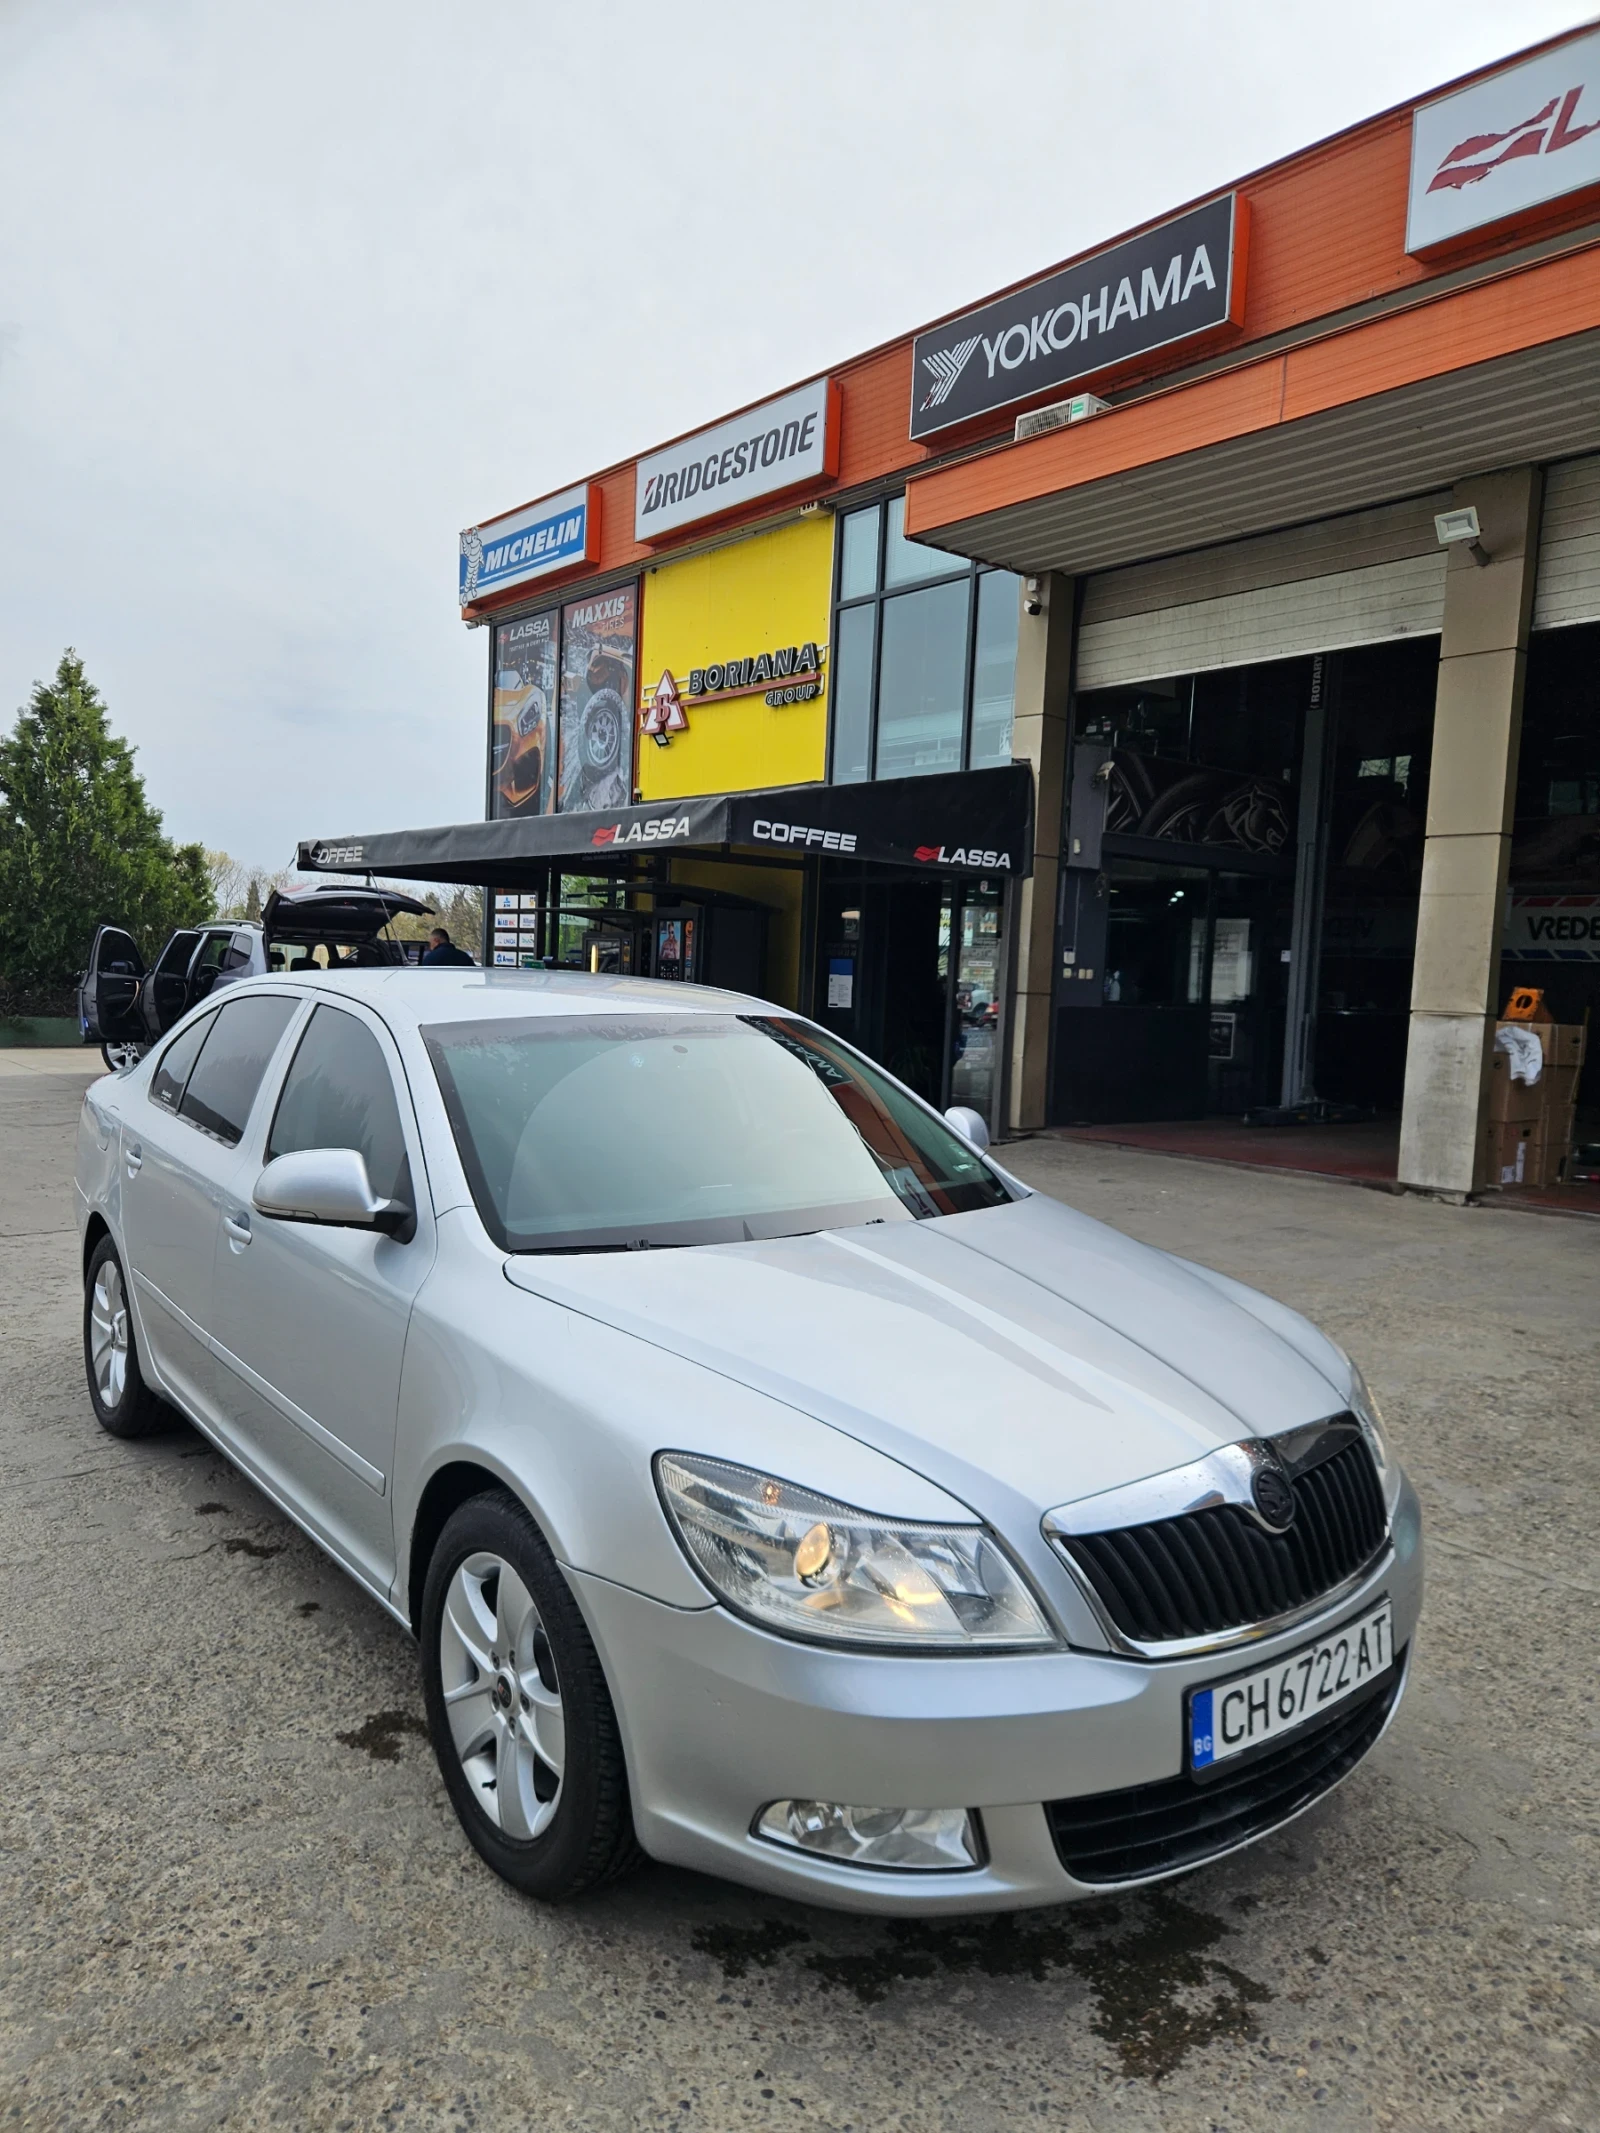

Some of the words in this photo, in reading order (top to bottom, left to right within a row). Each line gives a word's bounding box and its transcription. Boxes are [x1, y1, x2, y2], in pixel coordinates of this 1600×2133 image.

[1545, 83, 1600, 154] L
[981, 243, 1216, 379] YOKOHAMA
[641, 411, 818, 516] BRIDGESTONE
[484, 514, 582, 573] MICHELIN
[571, 597, 626, 629] MAXXIS
[509, 618, 550, 642] LASSA
[688, 642, 819, 696] BORIANA
[1310, 655, 1323, 703] ROTARY
[765, 684, 818, 708] GROUP
[612, 816, 690, 844] LASSA
[752, 819, 858, 852] COFFEE
[937, 846, 1011, 869] LASSA
[1193, 1735, 1213, 1756] BG
